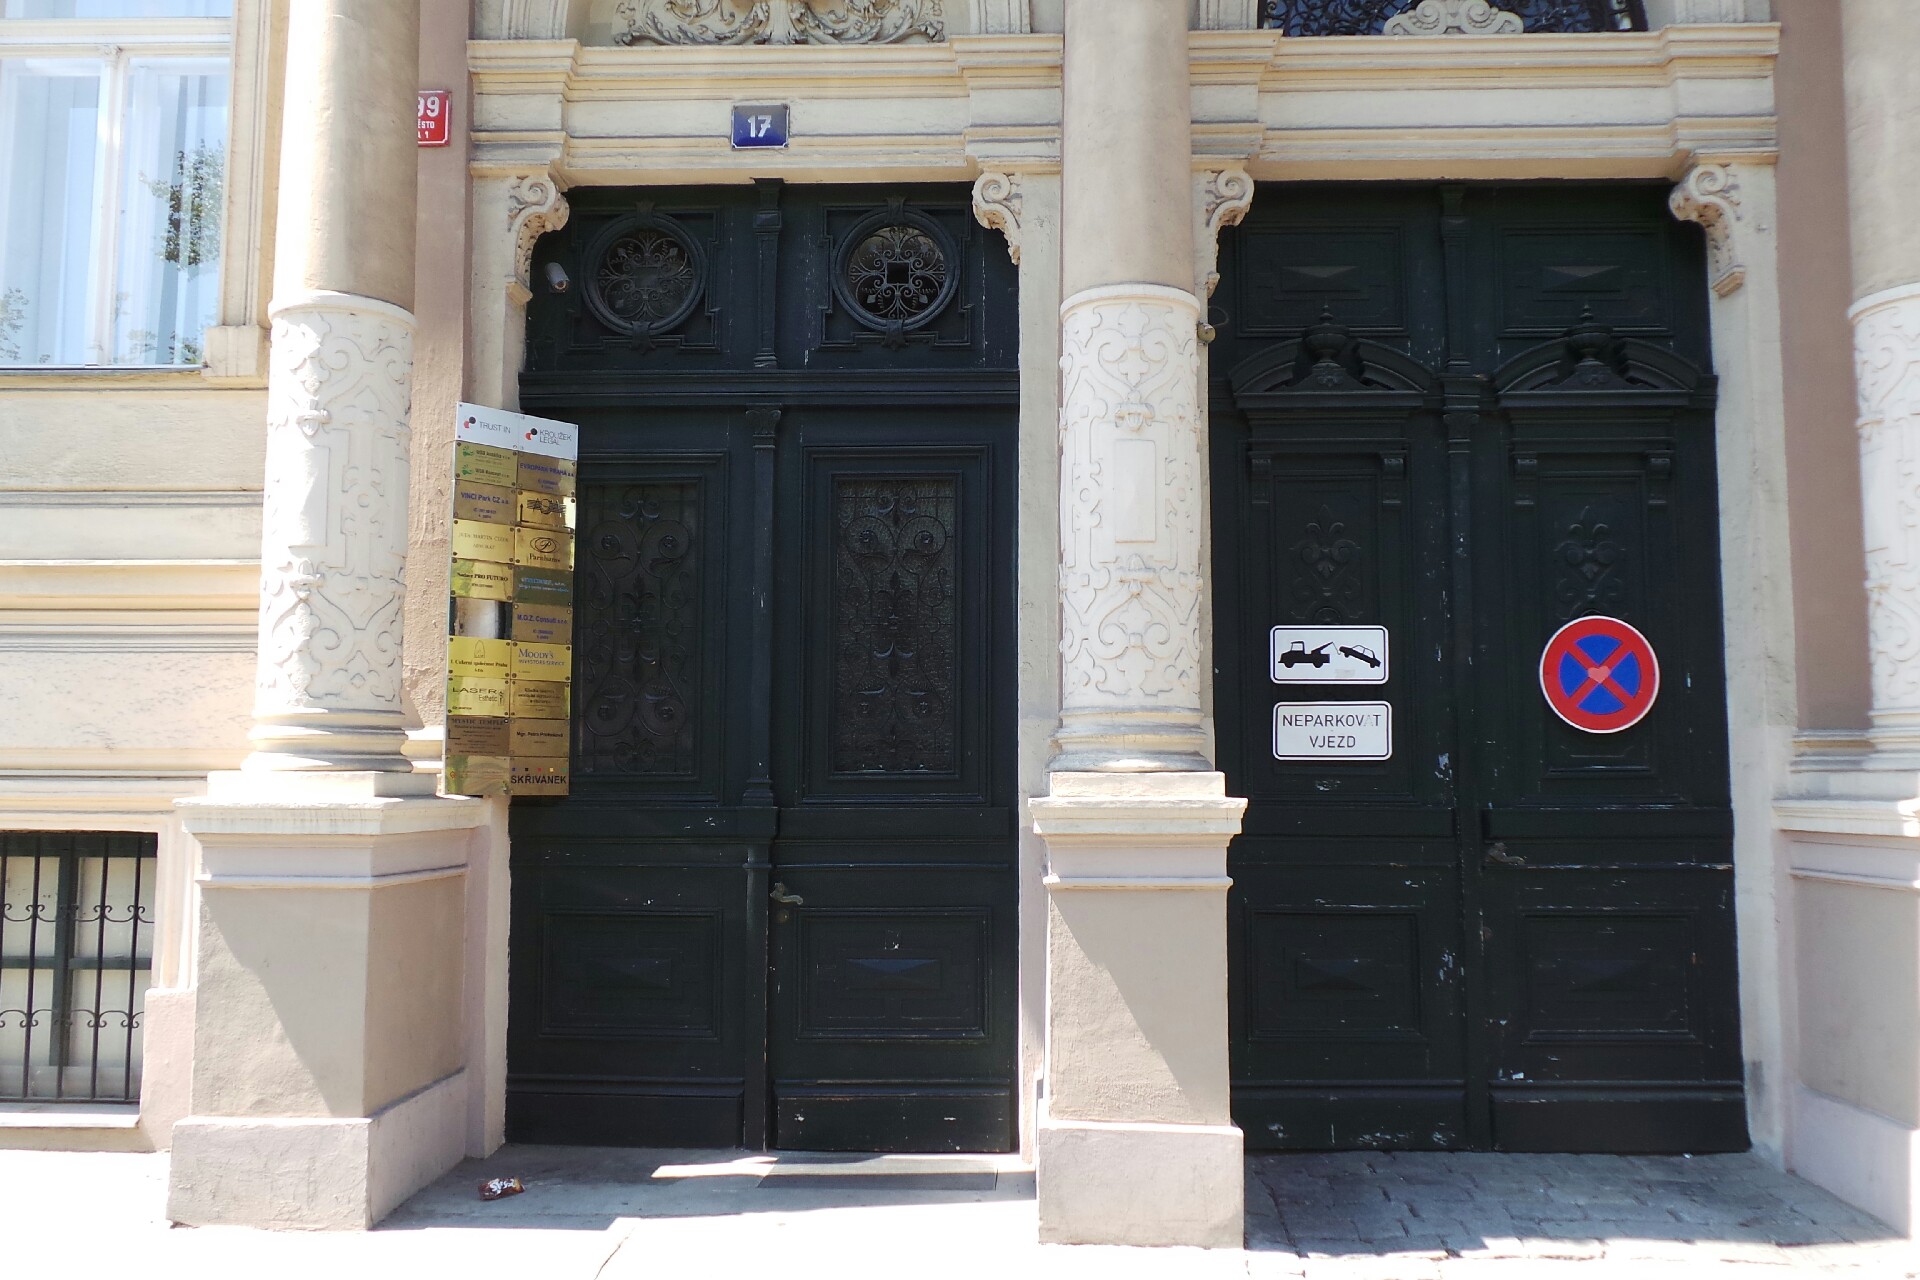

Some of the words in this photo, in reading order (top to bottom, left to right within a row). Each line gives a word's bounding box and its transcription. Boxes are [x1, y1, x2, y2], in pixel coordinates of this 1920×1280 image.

[747, 115, 771, 138] 17
[425, 131, 429, 139] 1
[480, 421, 502, 432] TRUST
[503, 426, 511, 434] IN
[539, 437, 560, 446] LEGAL
[461, 492, 477, 501] VINCI
[478, 494, 491, 502] Park
[492, 496, 501, 504] CZ
[452, 687, 498, 695] LASER
[1309, 735, 1356, 748] VJEZD
